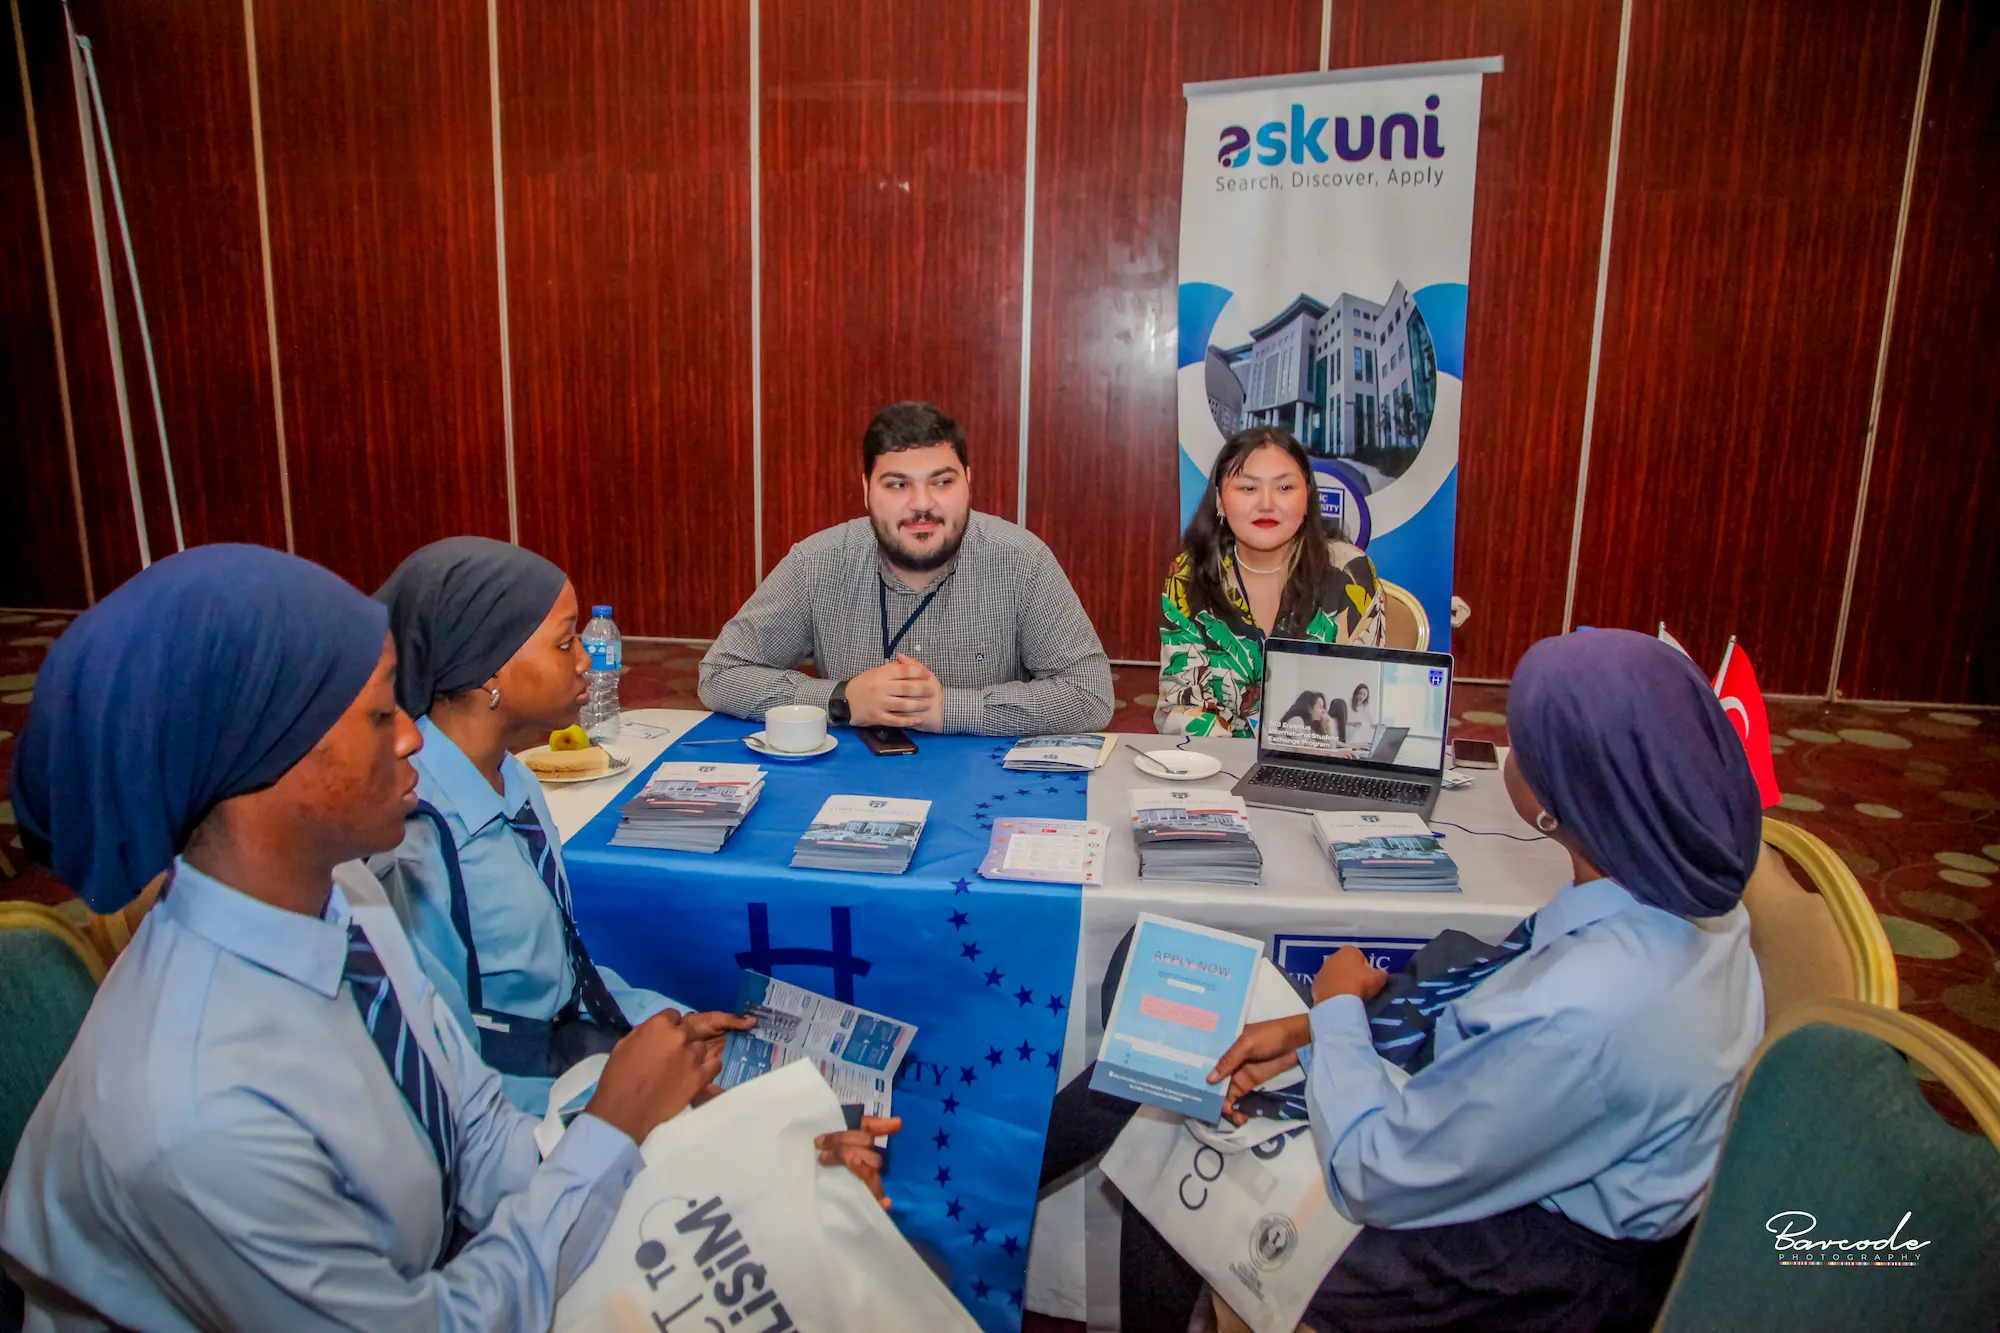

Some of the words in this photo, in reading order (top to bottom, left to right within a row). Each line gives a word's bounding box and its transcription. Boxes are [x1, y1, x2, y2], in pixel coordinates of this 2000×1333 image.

[1217, 93, 1445, 168] askuni
[1216, 171, 1284, 192] Search,
[1292, 169, 1379, 189] Discover,
[1387, 166, 1444, 188] Apply
[1268, 735, 1300, 745] Exchange
[1301, 739, 1331, 748] Program
[1311, 733, 1340, 742] Student
[1153, 950, 1194, 966] APPLY
[1197, 960, 1231, 977] NOW
